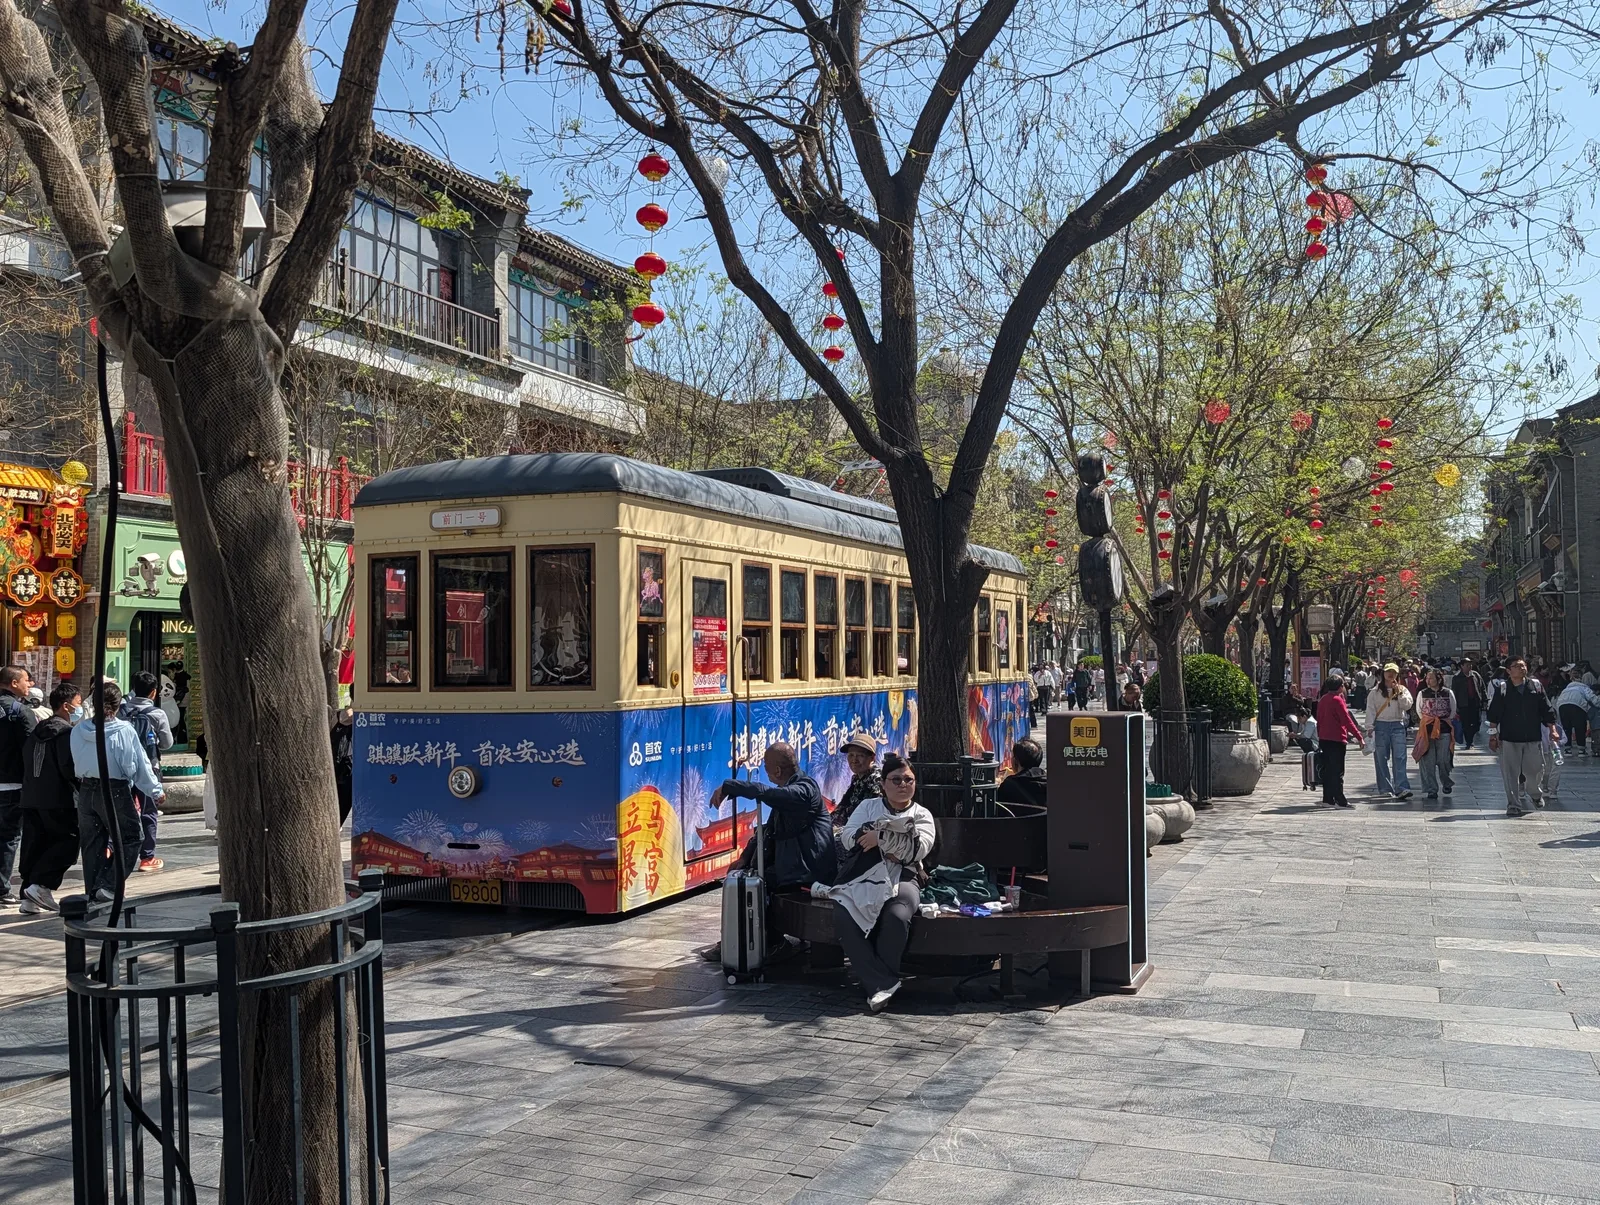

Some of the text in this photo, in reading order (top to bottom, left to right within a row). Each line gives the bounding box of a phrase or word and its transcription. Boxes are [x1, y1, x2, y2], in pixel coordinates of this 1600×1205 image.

[442, 511, 487, 525] 前门一号
[56, 513, 74, 549] 北京必买
[16, 574, 38, 585] 品质
[57, 578, 77, 588] 古法
[15, 585, 38, 596] 传承
[57, 587, 77, 598] 技艺
[369, 713, 386, 722] 首农
[1074, 726, 1097, 738] 美团
[366, 738, 587, 769] 骐骥跃新年 首农安心选
[645, 741, 662, 755] 首农
[1063, 746, 1109, 758] 便民充电
[618, 800, 666, 841] 立马
[617, 840, 664, 896] 暴富
[452, 884, 500, 903] D9800
